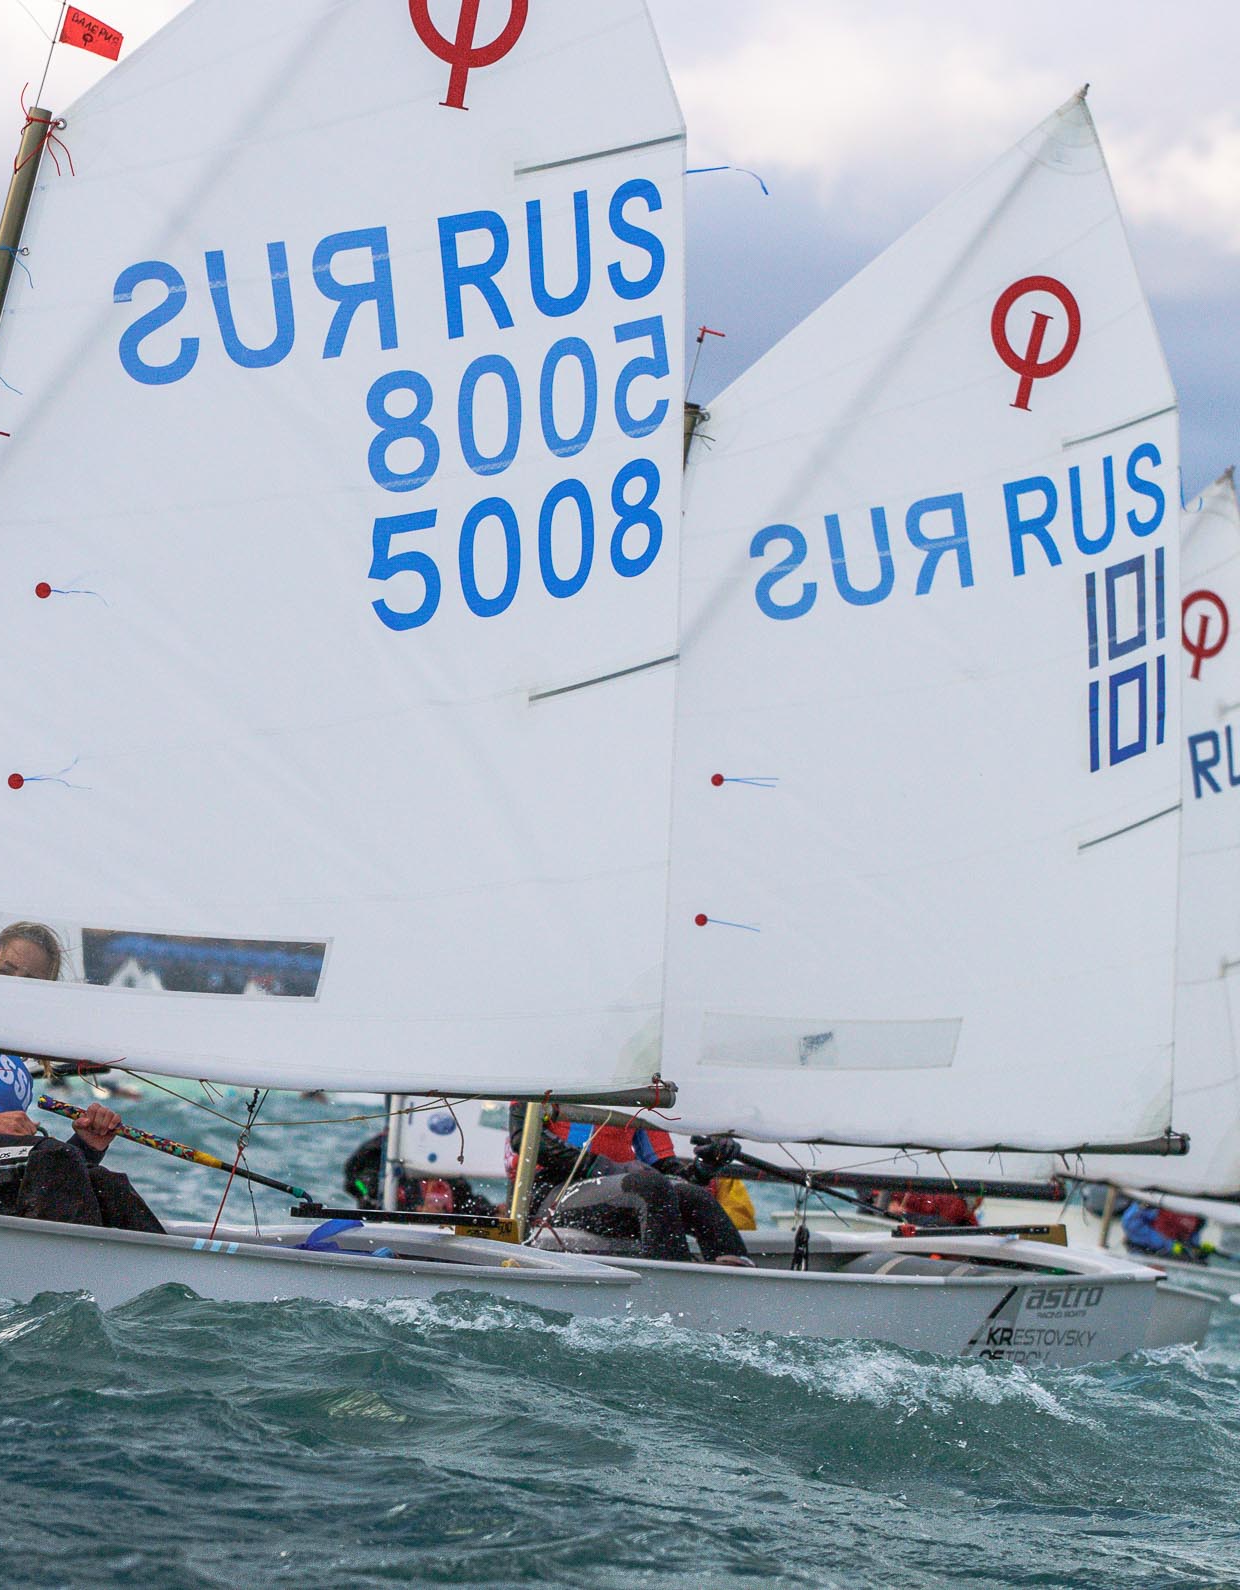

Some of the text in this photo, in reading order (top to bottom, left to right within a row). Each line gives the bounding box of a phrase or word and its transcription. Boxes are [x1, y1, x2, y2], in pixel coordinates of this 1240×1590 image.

[437, 178, 666, 339] RUS
[367, 458, 664, 632] 5008
[1003, 442, 1166, 577] RUS
[1088, 654, 1167, 773] 101
[986, 1327, 1097, 1347] KRESTOVSKY
[1025, 1284, 1104, 1310] astro
